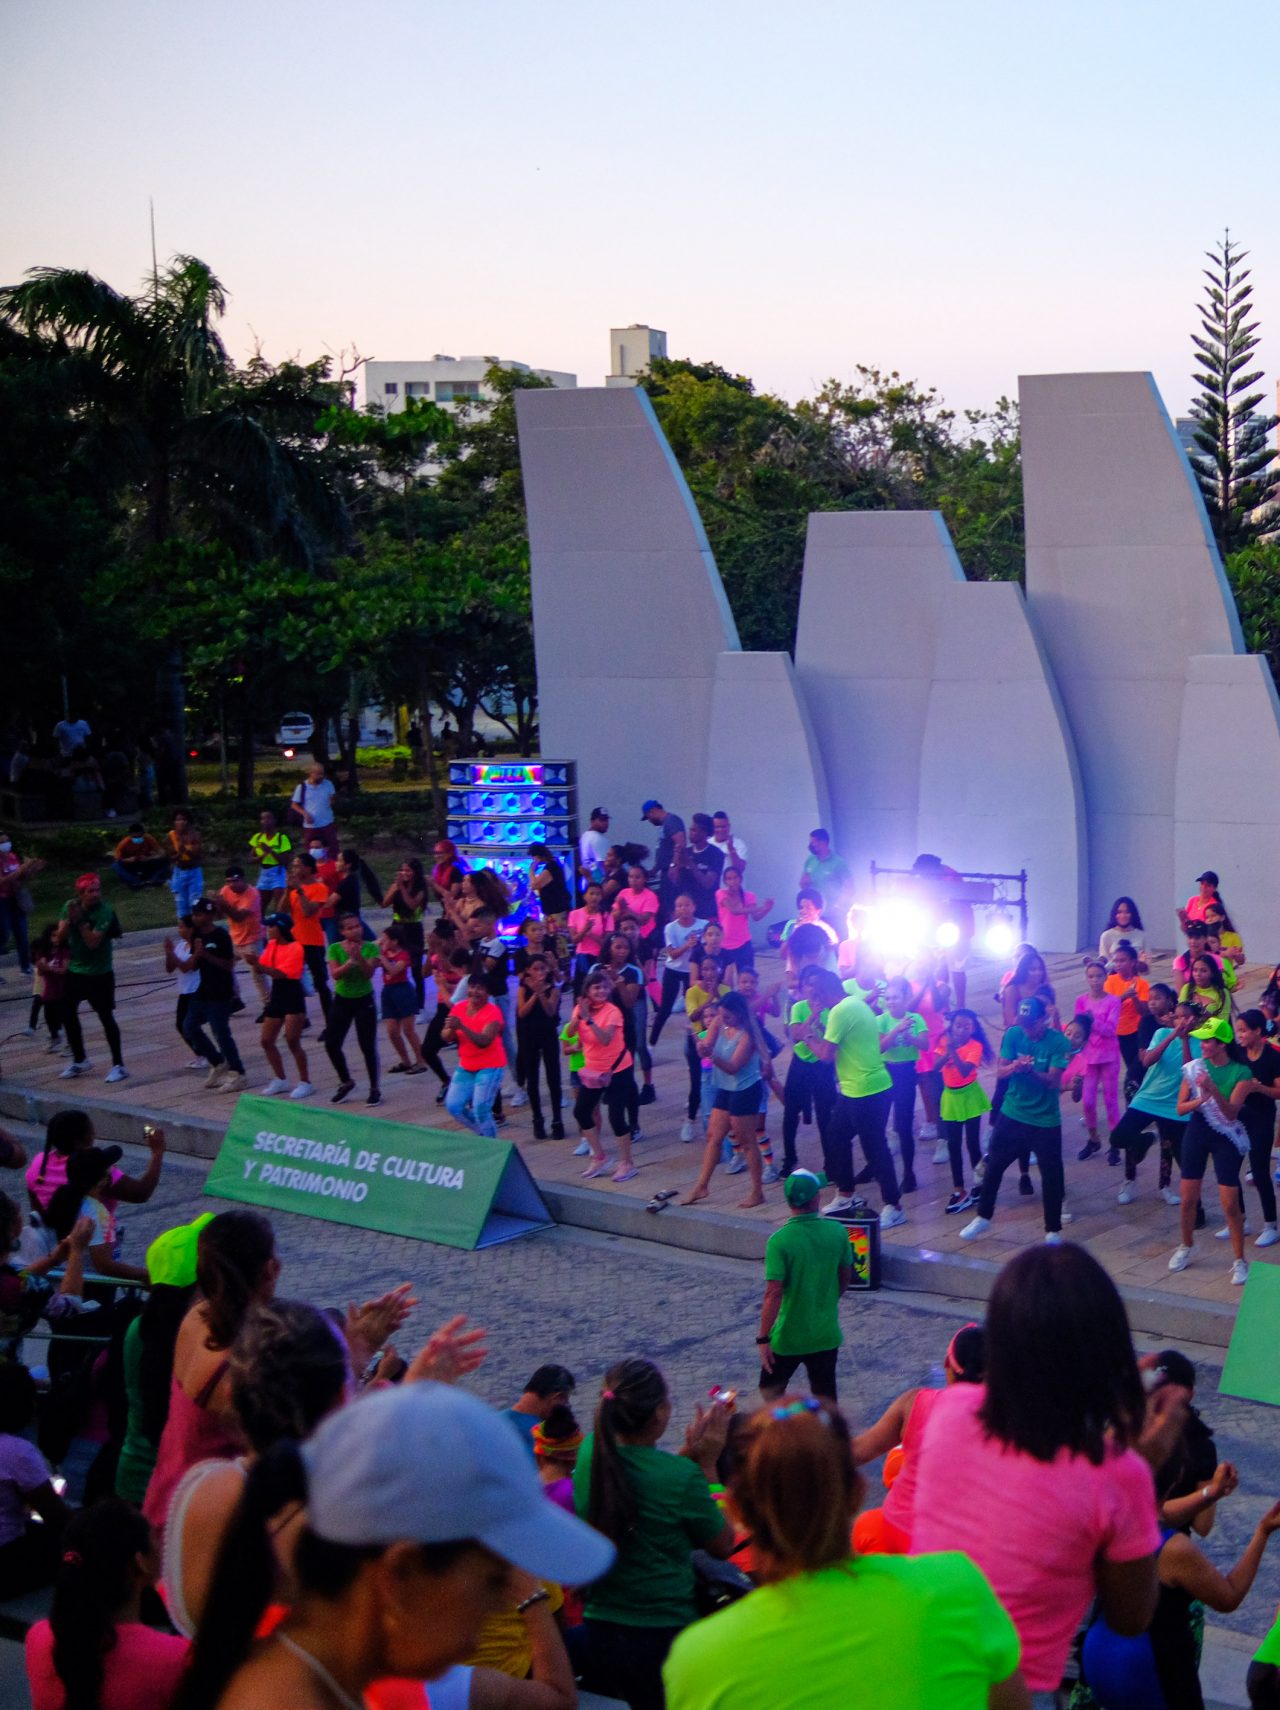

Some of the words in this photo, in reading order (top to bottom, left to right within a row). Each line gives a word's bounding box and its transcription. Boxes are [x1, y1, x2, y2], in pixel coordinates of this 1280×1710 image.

[243, 1160, 257, 1179] Y
[259, 1163, 369, 1202] PATRIMONIO
[253, 1131, 352, 1167] SECRETARÍA
[354, 1151, 381, 1173] DE
[382, 1156, 465, 1190] CULTURA
